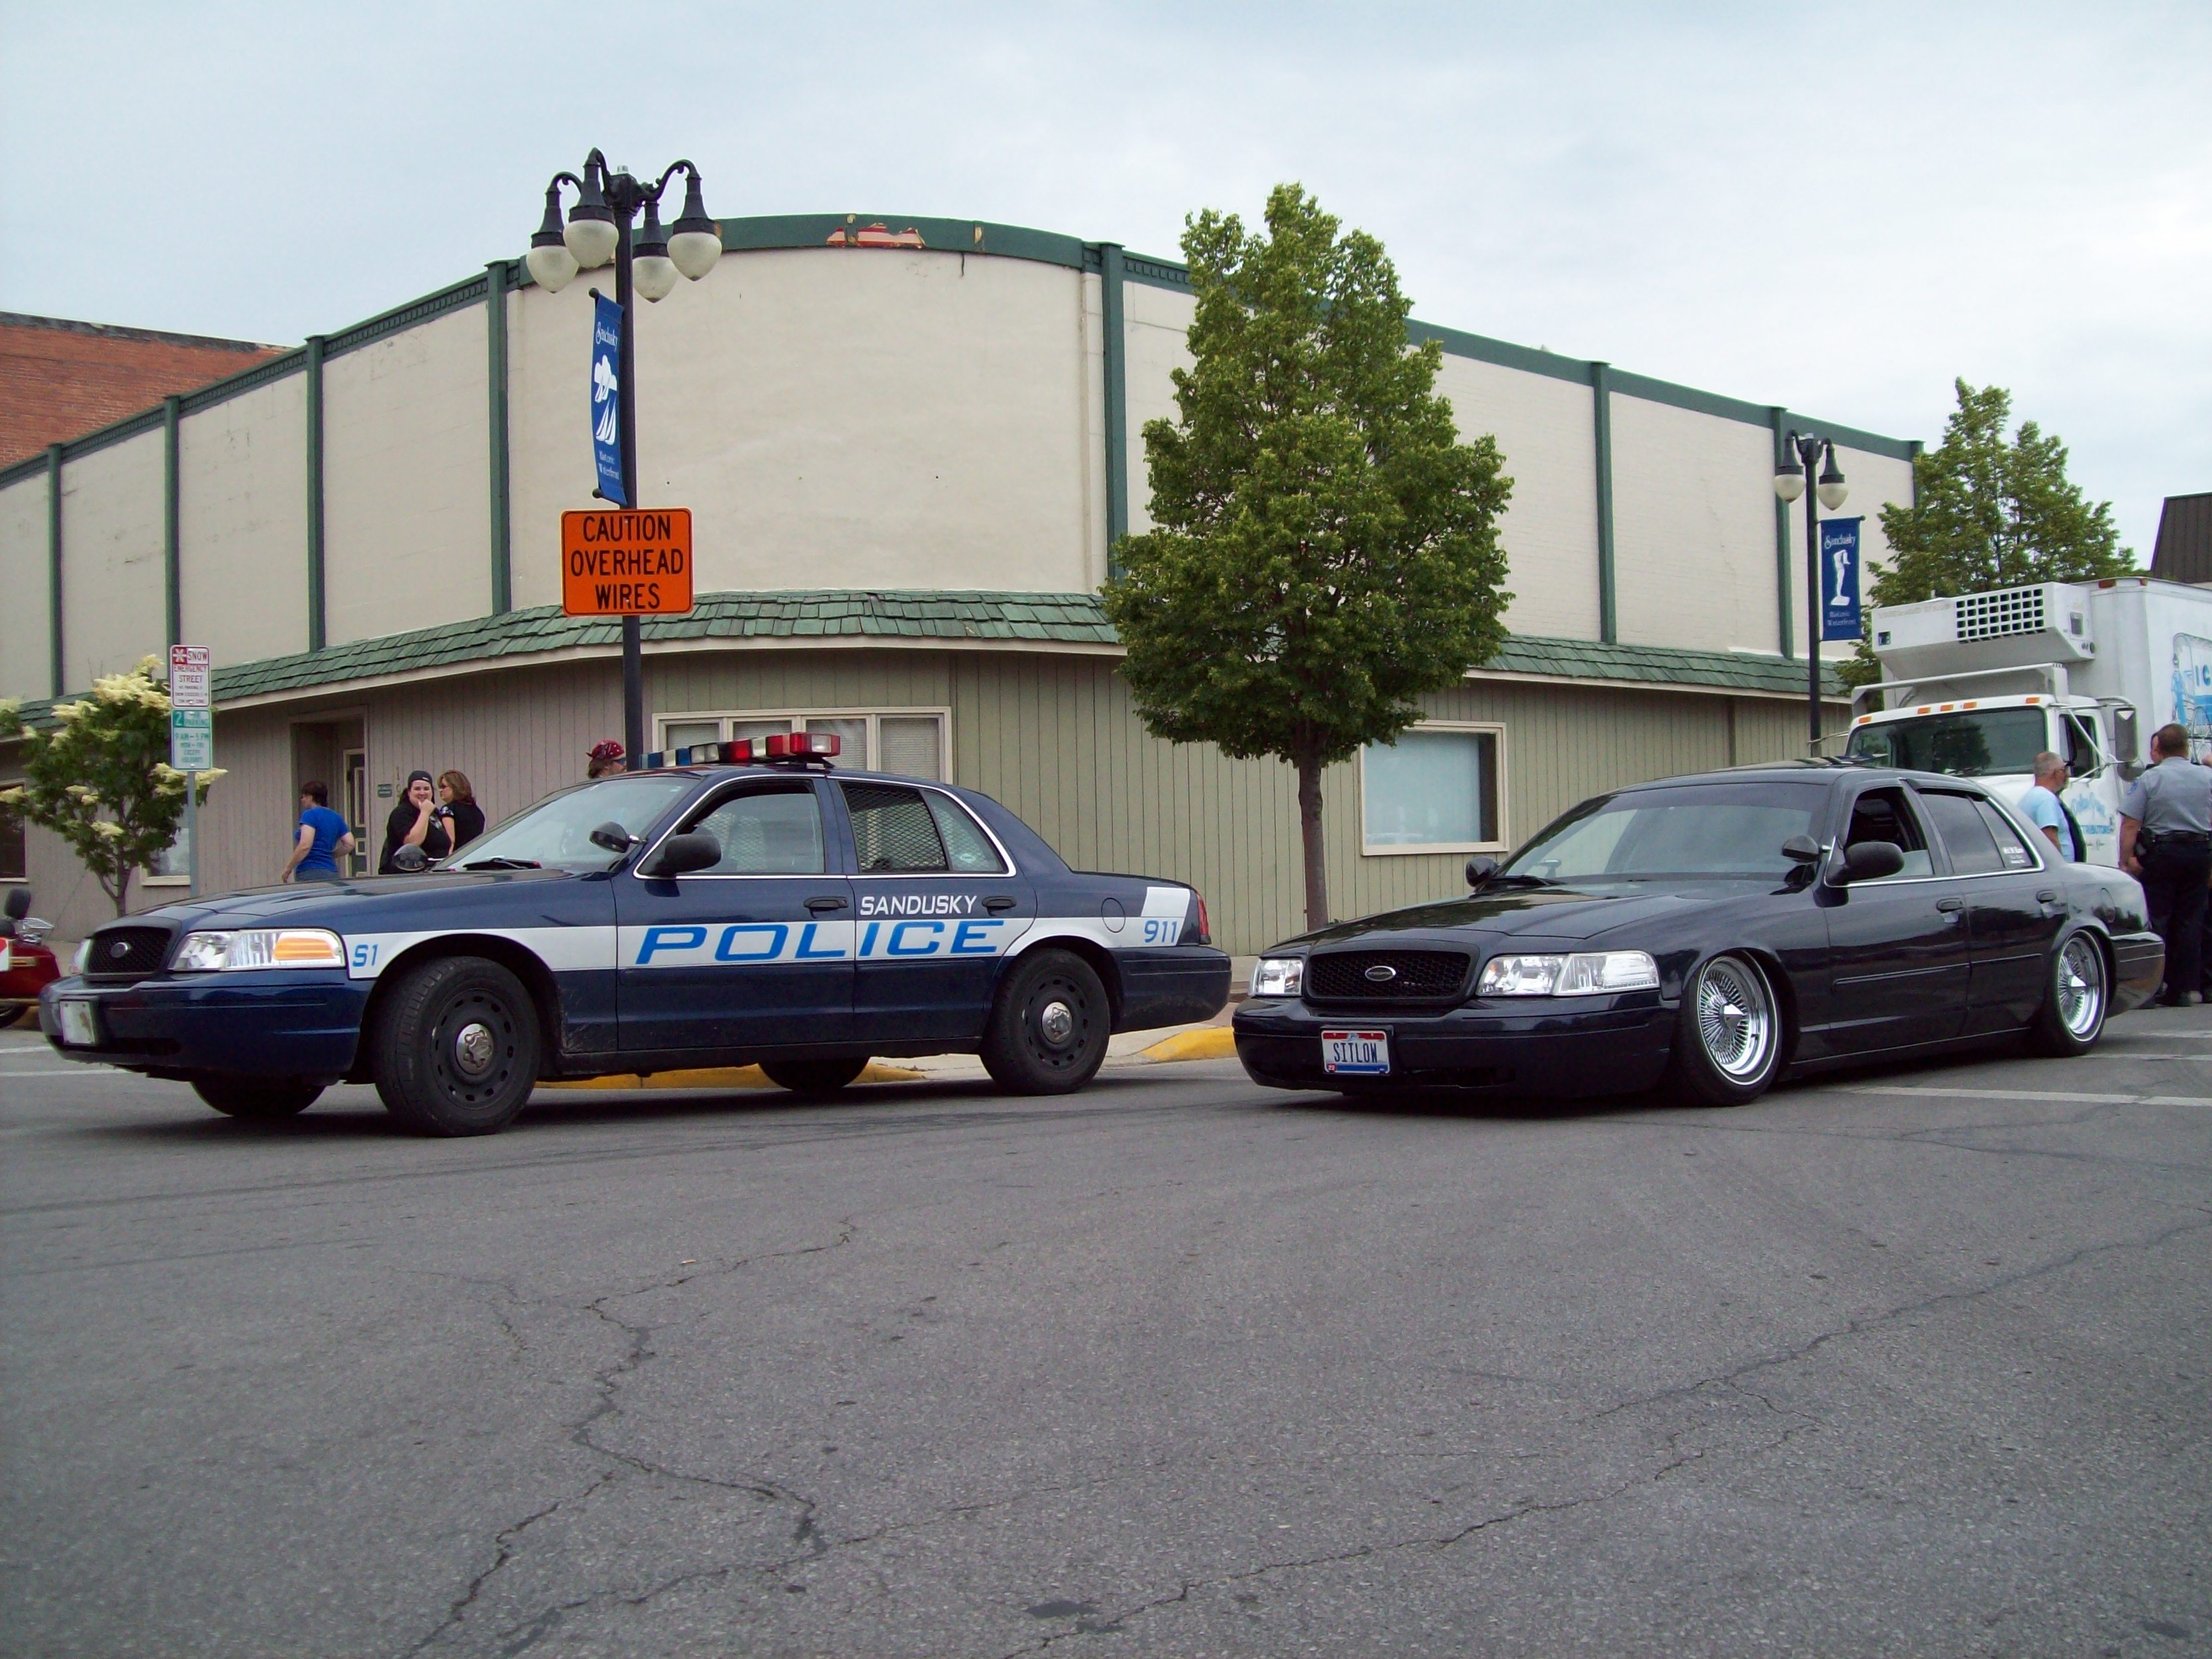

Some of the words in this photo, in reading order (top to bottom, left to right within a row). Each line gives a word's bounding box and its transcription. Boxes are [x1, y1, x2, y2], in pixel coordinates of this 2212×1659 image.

[595, 321, 618, 352] Sandusky
[583, 514, 670, 542] CAUTION
[1824, 533, 1856, 550] Sandusky
[570, 548, 683, 576] OVERHEAD
[595, 582, 660, 610] WIRES
[188, 651, 207, 660] SNOW
[179, 674, 203, 683] STREET
[176, 711, 182, 726] 2
[860, 895, 977, 915] SANDUSKY
[635, 920, 1005, 965] POLICE
[1144, 920, 1177, 943] 911
[352, 944, 378, 967] S1
[1333, 1042, 1378, 1063] SITLOW
